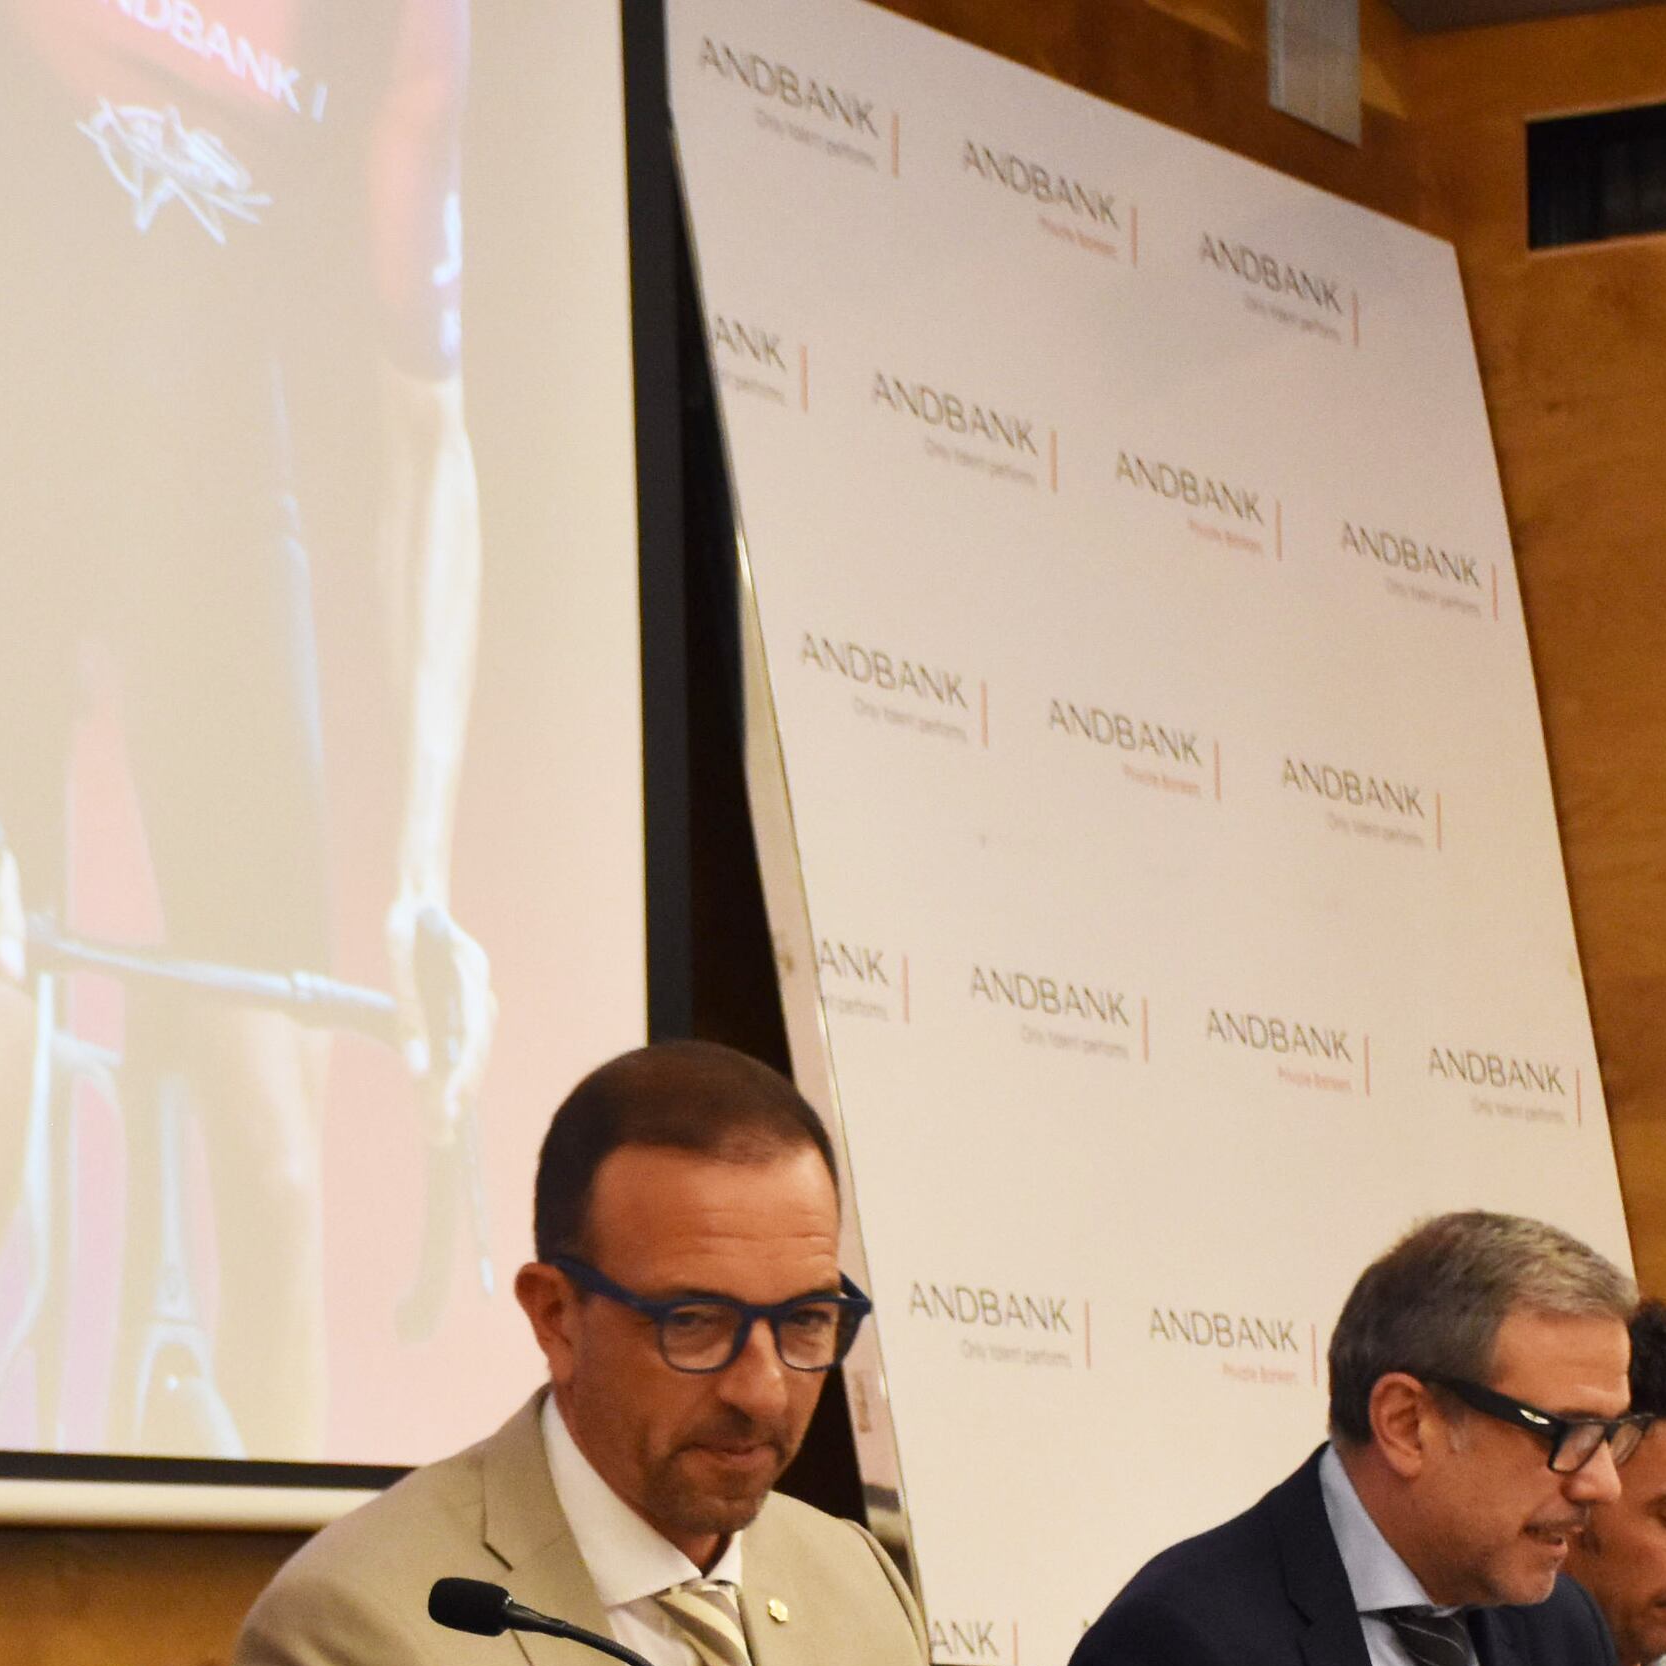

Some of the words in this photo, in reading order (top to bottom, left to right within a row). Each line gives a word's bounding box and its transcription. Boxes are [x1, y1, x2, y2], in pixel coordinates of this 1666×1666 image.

[699, 34, 879, 138] ANDBANK
[963, 139, 1120, 231] ANDBANK
[1199, 231, 1343, 315] ANDBANK
[714, 314, 787, 373] ANK
[873, 370, 1039, 457] ANDBANK
[1115, 450, 1265, 526] ANDBANK
[1341, 520, 1483, 590] ANDBANK
[800, 632, 969, 711] ANDBANK
[1048, 698, 1203, 767] ANDBANK
[1280, 757, 1426, 819] ANDBANK
[818, 938, 890, 987] ANK
[970, 963, 1130, 1027] ANDBANK
[1205, 1009, 1354, 1064] ANDBANK
[1429, 1047, 1566, 1097] ANDBANK
[907, 1280, 1073, 1335] ANDBANK
[1148, 1307, 1300, 1354] ANDBANK
[931, 1619, 1000, 1658] ANK
